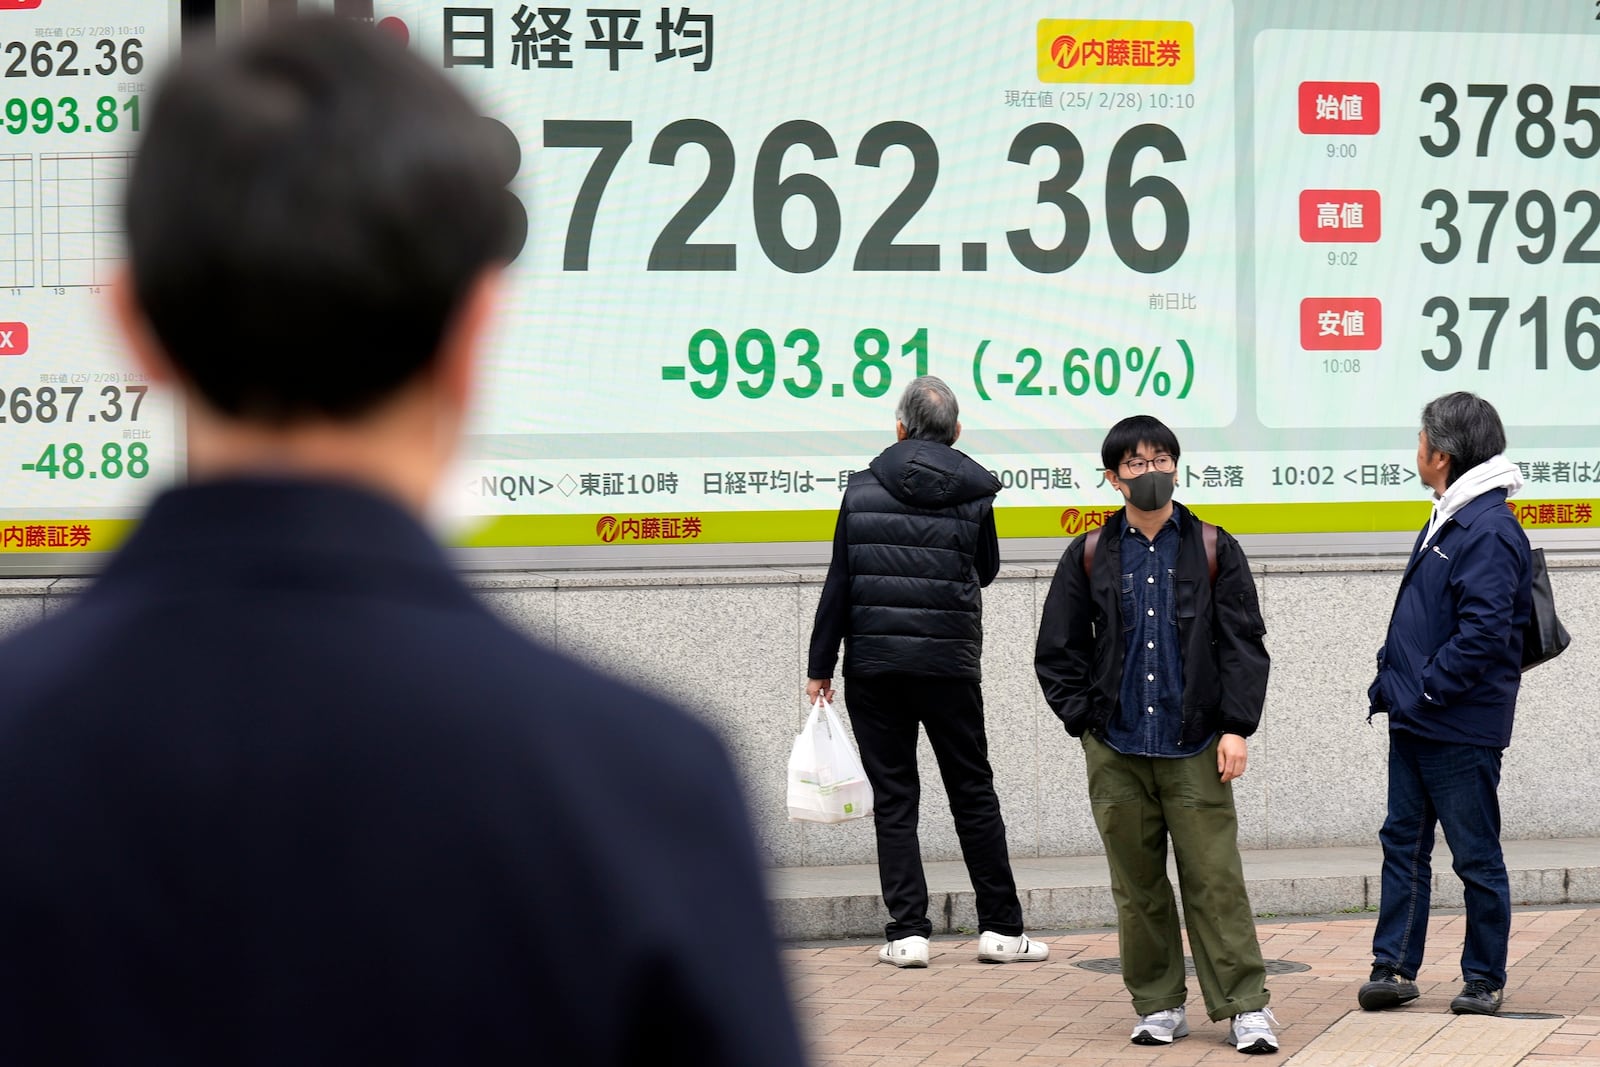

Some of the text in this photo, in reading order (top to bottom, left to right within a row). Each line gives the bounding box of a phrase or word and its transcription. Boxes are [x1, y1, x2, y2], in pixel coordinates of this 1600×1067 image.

[443, 4, 714, 72] 日経平均
[0, 38, 144, 77] 262.36
[1082, 38, 1181, 67] 内藤証券
[1004, 90, 1195, 111] 現在値 (25/ 2/28) 10:10
[1315, 94, 1363, 121] 始値
[0, 95, 140, 134] 993.81
[1419, 82, 1600, 159] 3785
[1327, 143, 1357, 158] 9:00
[1316, 202, 1364, 229] 高値
[1420, 189, 1600, 265] 3792
[1327, 251, 1358, 266] 9:02
[1149, 293, 1197, 310] 前日比
[1317, 310, 1365, 336] 安値
[1421, 296, 1600, 371] 3716
[661, 328, 1195, 401] -993.81 (-2.60%)
[1322, 359, 1361, 373] 10:08
[0, 385, 149, 424] 687.37
[21, 442, 149, 480] -48.88
[1272, 466, 1334, 485] 10:02
[1521, 503, 1592, 525] 内藤証券
[3, 525, 91, 548] 内藤証券
[621, 516, 702, 540] 内藤証券
